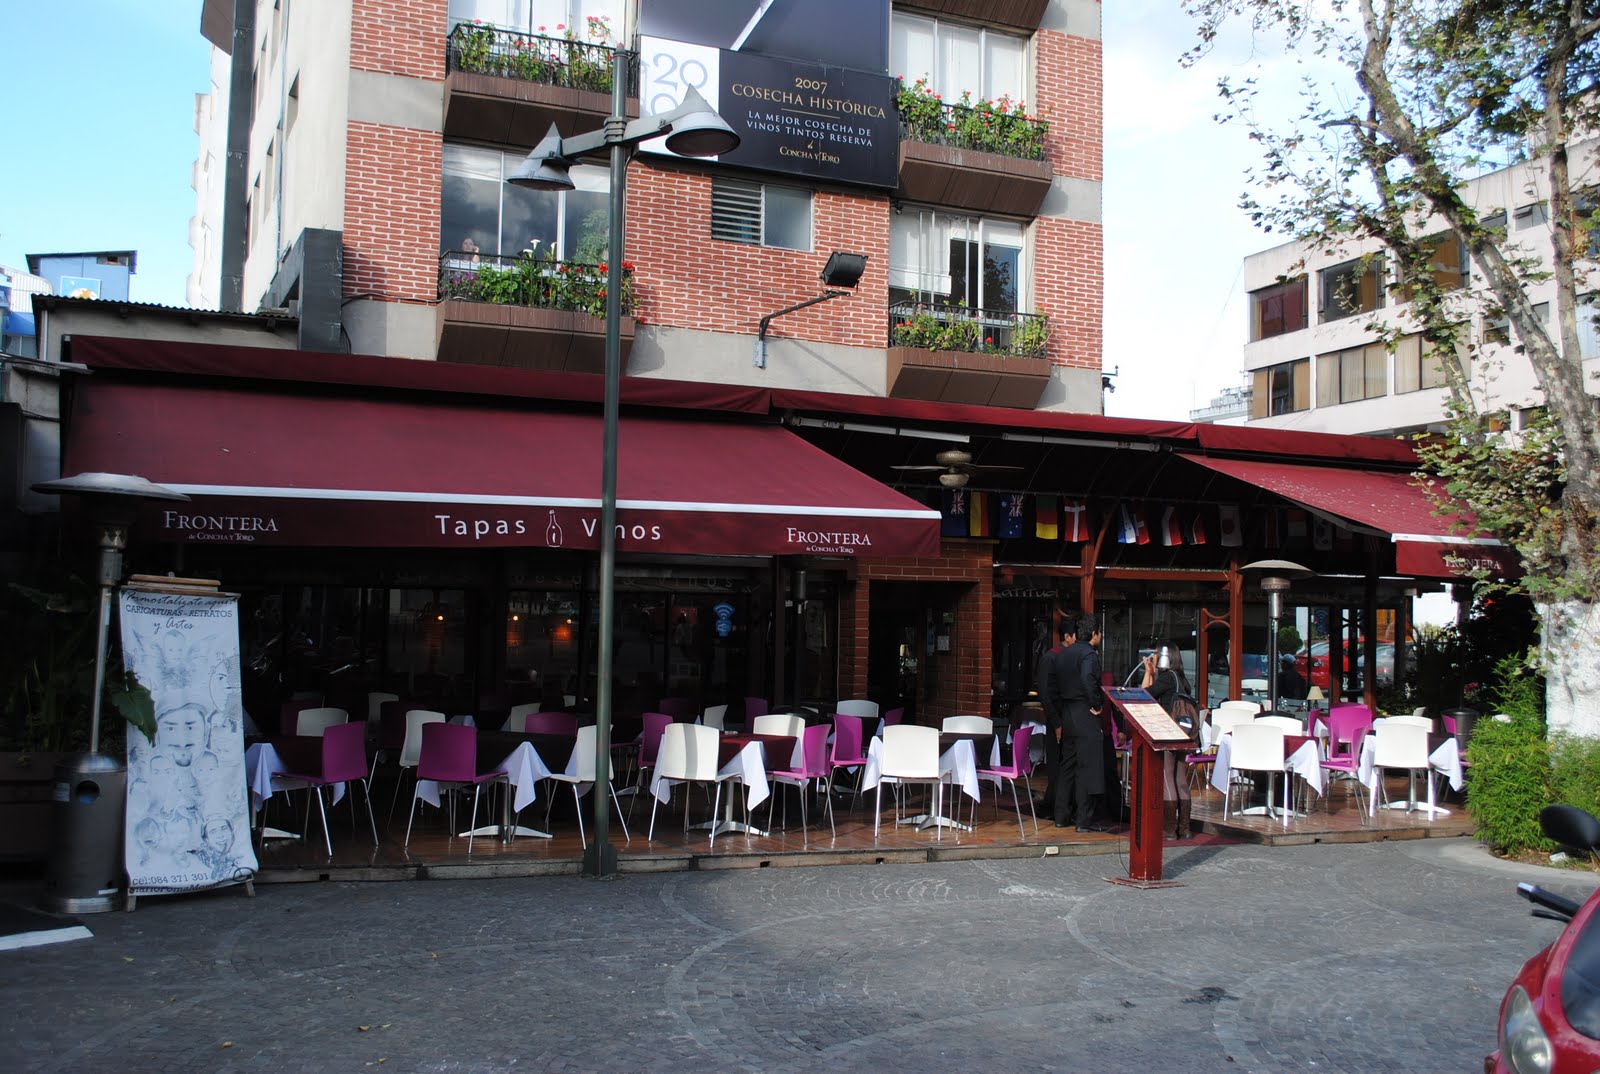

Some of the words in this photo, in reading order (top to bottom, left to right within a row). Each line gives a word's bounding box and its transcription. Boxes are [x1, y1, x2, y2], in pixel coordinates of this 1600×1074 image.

[795, 77, 828, 94] 2007
[732, 83, 804, 106] COSECHA
[810, 96, 886, 119] HISTÓRICA
[746, 120, 781, 133] VINOS
[785, 126, 825, 140] TINTOS
[829, 133, 873, 147] RESERVA
[748, 110, 761, 120] LA
[766, 112, 801, 126] MEJOR
[804, 119, 854, 134] COSECHA
[858, 128, 872, 137] DE
[163, 510, 279, 532] FRONTERA
[435, 514, 526, 540] Tapas
[581, 517, 662, 541] Vnos
[786, 527, 872, 546] FRONTERA
[1444, 556, 1501, 570] RNTERA
[125, 604, 183, 617] CARICATURAS
[188, 609, 233, 618] RETRATOS
[170, 874, 189, 883] 371
[191, 872, 209, 881] 301
